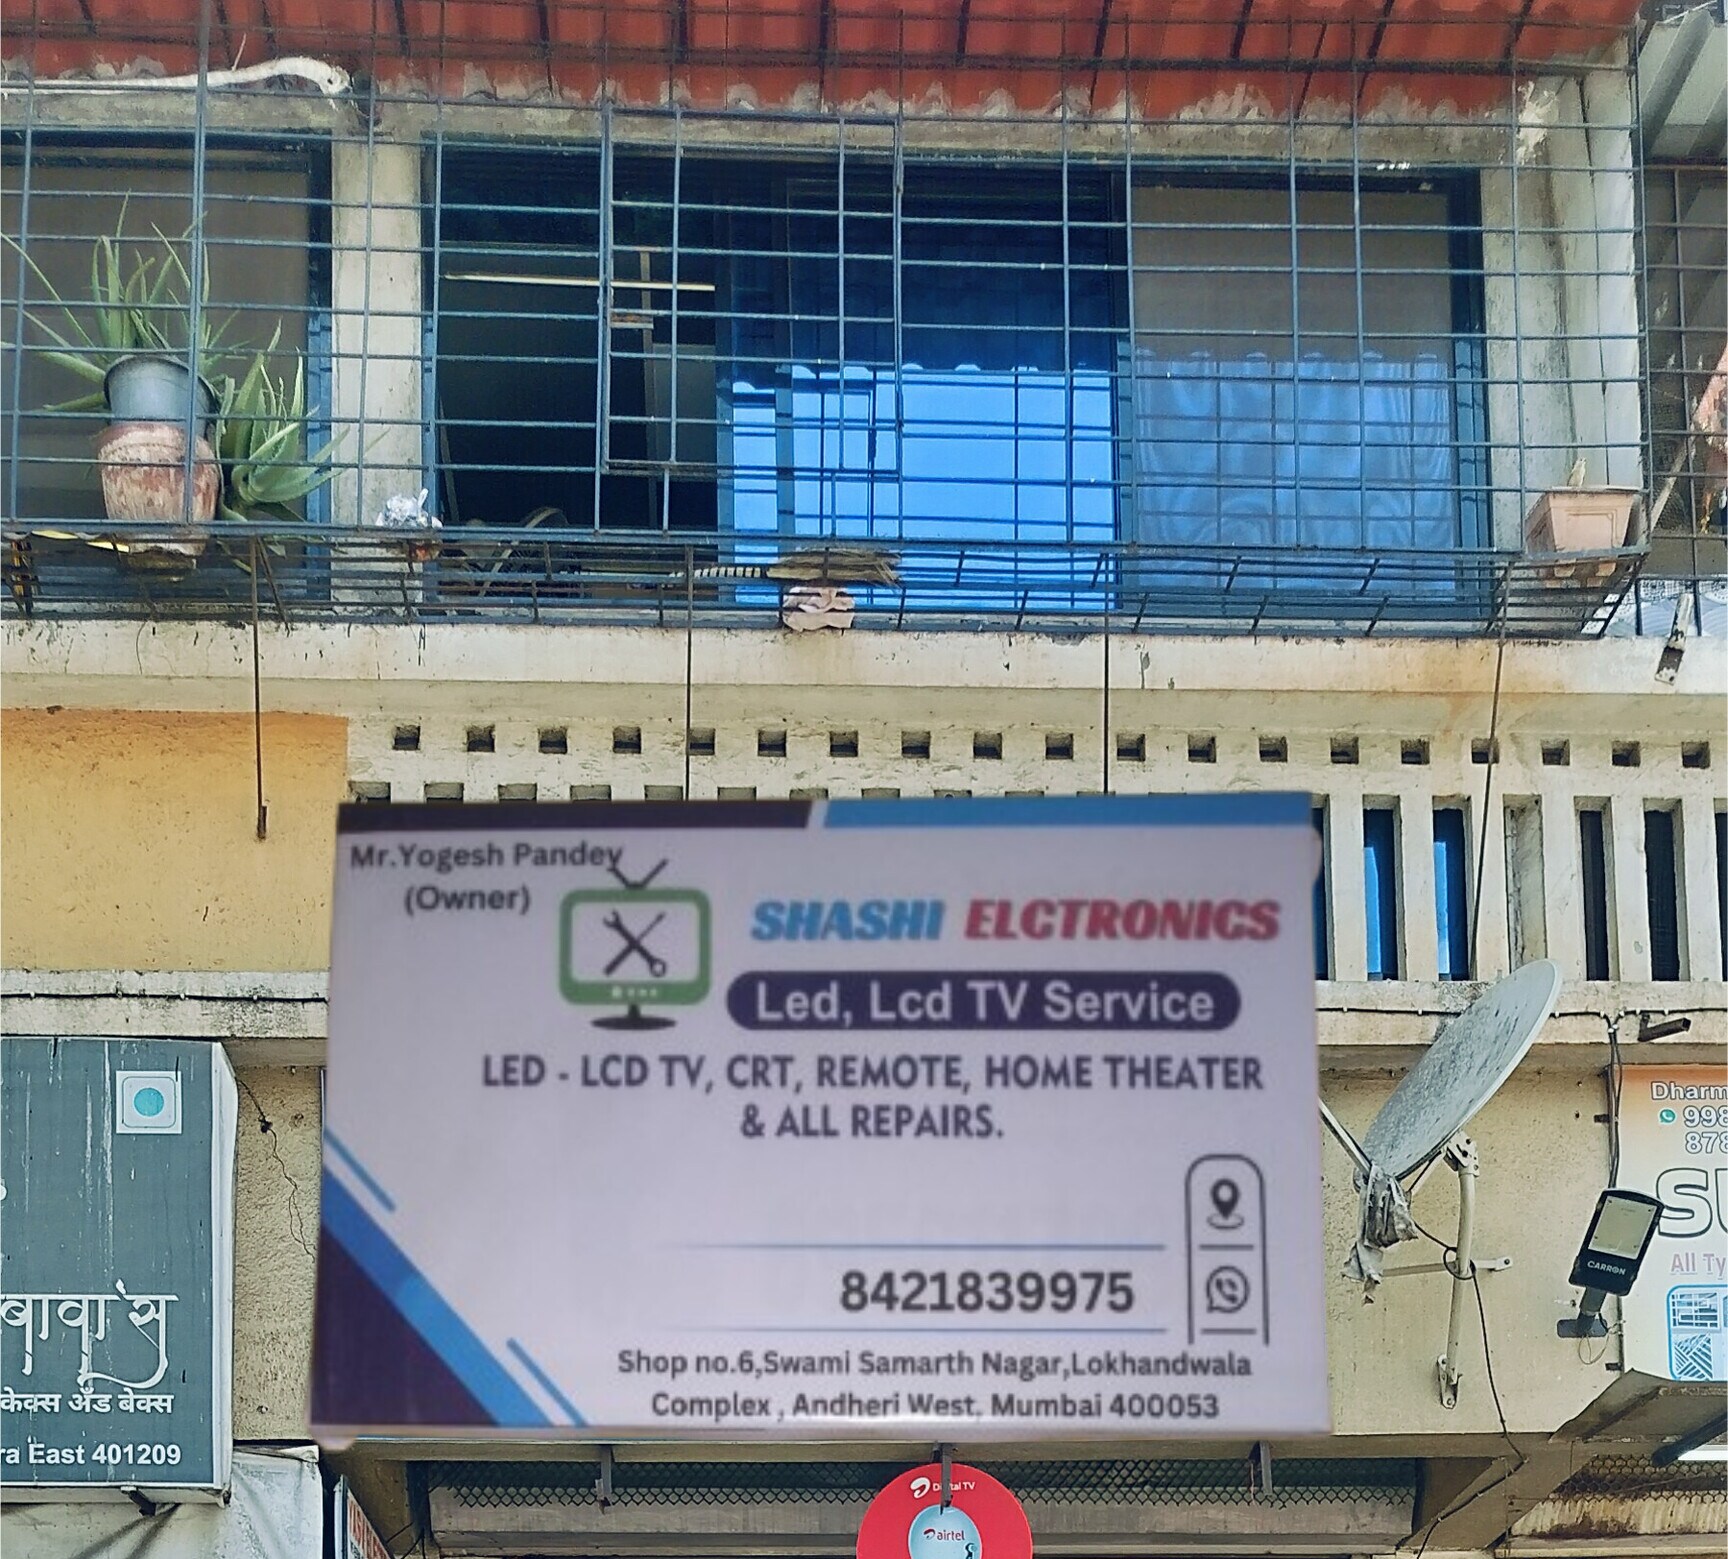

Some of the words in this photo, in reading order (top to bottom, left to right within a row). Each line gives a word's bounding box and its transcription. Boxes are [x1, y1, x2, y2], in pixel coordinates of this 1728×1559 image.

[350, 842, 504, 871] Mr.Yogesh
[514, 841, 623, 871] Pandey
[404, 885, 531, 916] (Owner)
[752, 900, 943, 941] SHASHI
[965, 899, 1279, 941] ELCTRONICS
[757, 981, 852, 1028] Led,
[870, 981, 952, 1021] Lcd
[967, 980, 1027, 1020] TV
[1044, 980, 1214, 1021] Service
[483, 1055, 546, 1087] LED
[581, 1054, 649, 1088] LCD
[658, 1054, 713, 1093] TV,
[726, 1054, 802, 1093] CRT,
[817, 1054, 971, 1093] REMOTE,
[985, 1054, 1092, 1089] HOME
[1102, 1055, 1264, 1090] THEATER
[740, 1103, 765, 1139] &
[775, 1104, 839, 1138] ALL
[851, 1104, 1003, 1138] REPAIRS.
[1587, 1260, 1627, 1276] CARRON
[1671, 1252, 1696, 1272] All
[840, 1270, 1135, 1313] 8421839975
[618, 1350, 688, 1379] Shop
[859, 1350, 974, 1376] Samarth
[651, 1391, 770, 1422] Complex
[792, 1392, 899, 1417] Andheri
[991, 1392, 1102, 1417] Mumbai
[1109, 1393, 1220, 1418] 400053
[28, 1443, 86, 1465] East
[91, 1443, 181, 1465] 401209
[962, 1481, 976, 1491] TV
[936, 1529, 966, 1542] airtel
